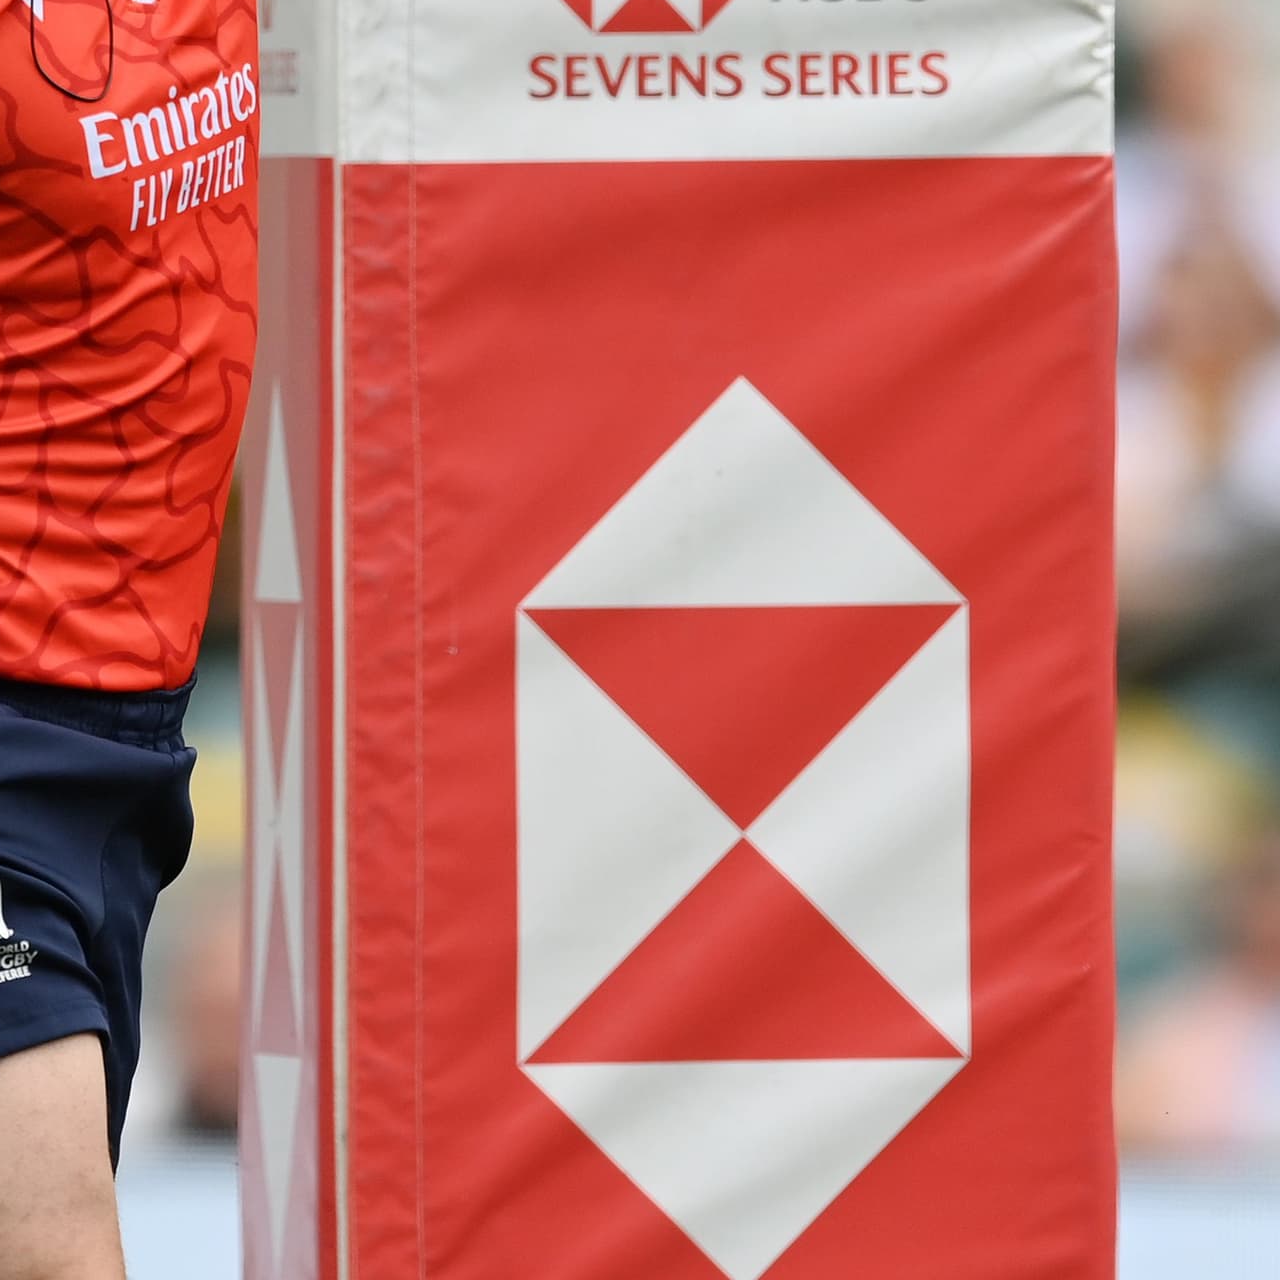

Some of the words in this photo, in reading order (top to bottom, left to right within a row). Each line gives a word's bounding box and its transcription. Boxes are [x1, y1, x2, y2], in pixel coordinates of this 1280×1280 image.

[79, 62, 257, 180] Emirates
[528, 53, 744, 99] SEVENS
[762, 52, 950, 98] SERIES
[130, 168, 174, 233] FLY
[176, 135, 246, 215] BETTER
